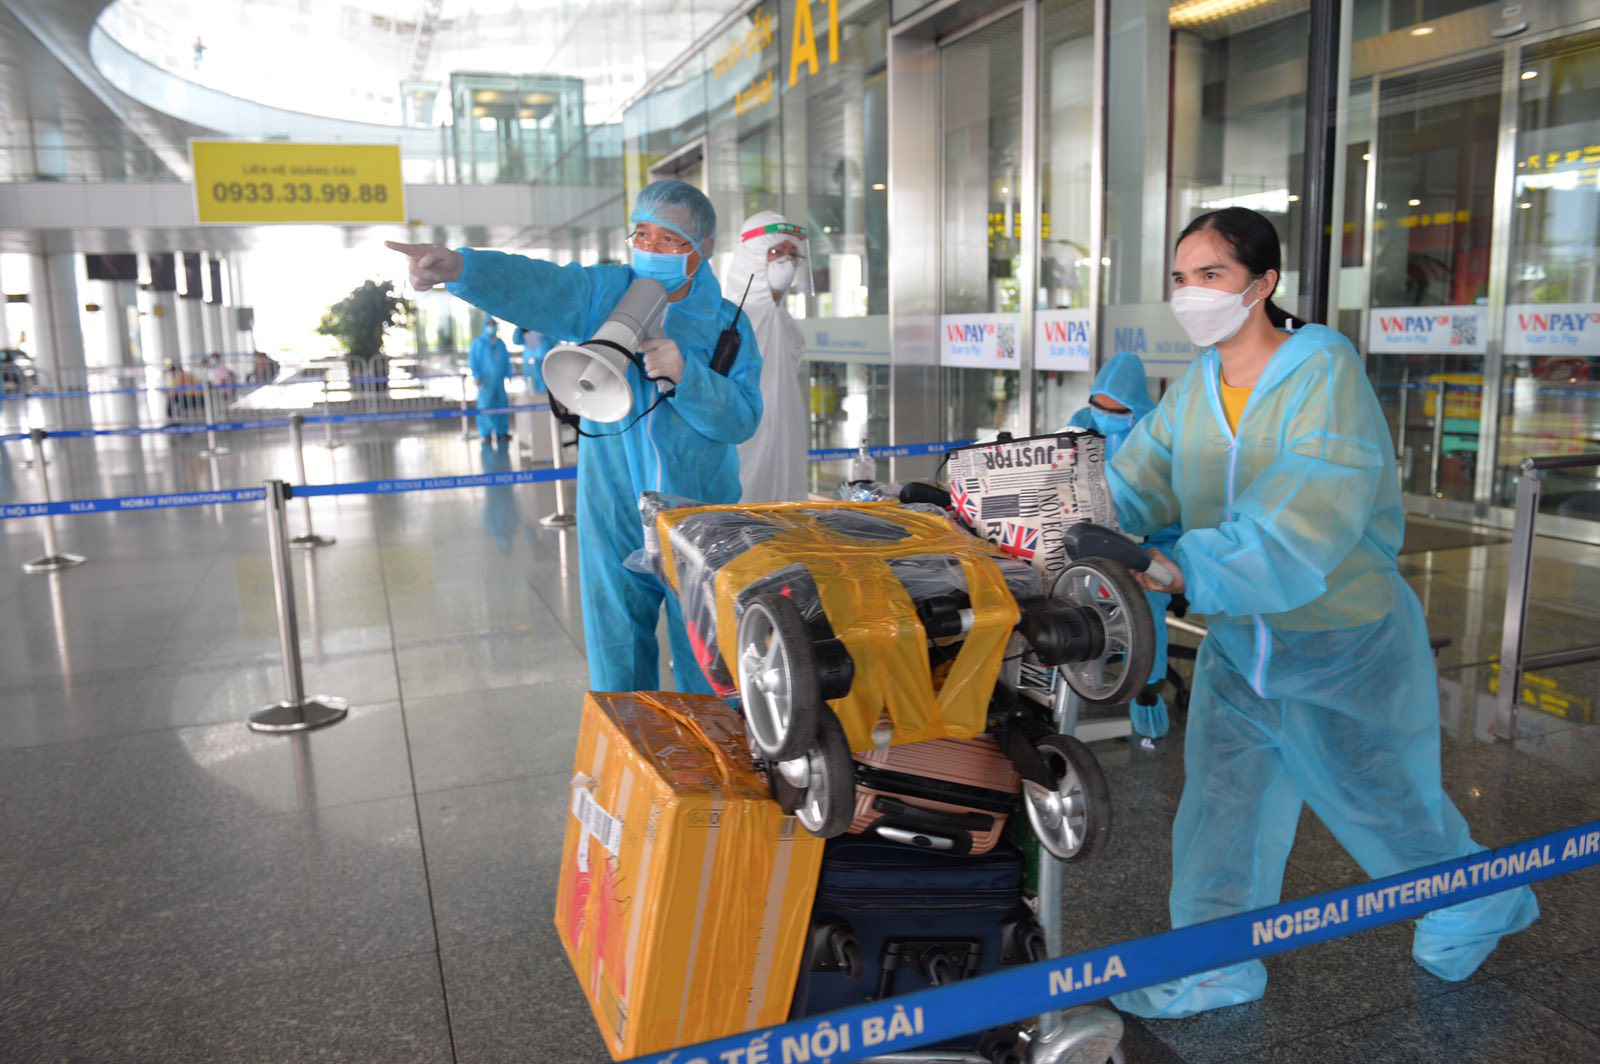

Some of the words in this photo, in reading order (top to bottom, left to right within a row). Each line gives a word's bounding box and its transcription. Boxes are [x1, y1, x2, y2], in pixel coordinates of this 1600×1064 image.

[212, 182, 389, 203] 0933.33.99.88
[1044, 320, 1090, 342] VNPA
[1016, 445, 1056, 468] JUST
[1252, 899, 1349, 946] NOIBAI
[1356, 845, 1555, 919] INTERNATIONAL
[1561, 831, 1600, 861] AIR
[1049, 955, 1127, 997] N.I.A
[781, 1020, 849, 1064] NỘI
[861, 1005, 925, 1048] BÀI
